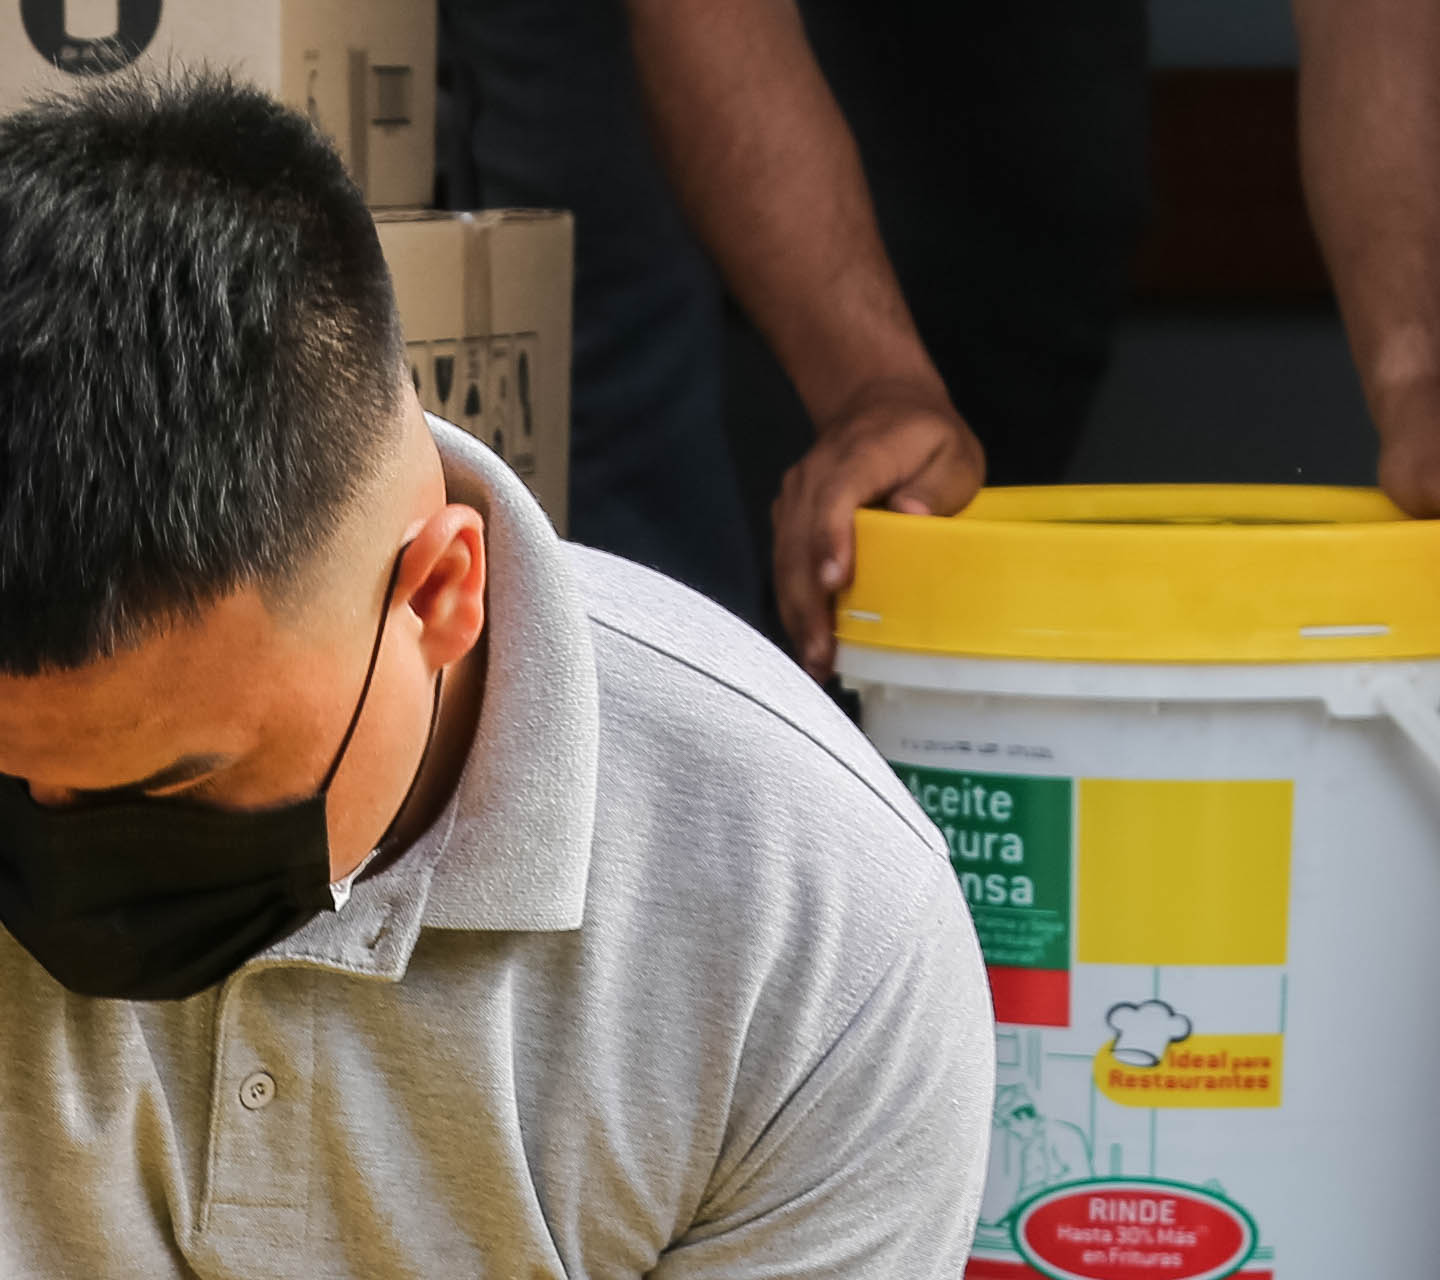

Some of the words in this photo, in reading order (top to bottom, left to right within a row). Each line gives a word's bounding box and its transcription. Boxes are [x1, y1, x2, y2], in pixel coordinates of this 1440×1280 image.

[1108, 1068, 1270, 1090] Restaurantes
[1088, 1197, 1177, 1224] RINDE
[1056, 1224, 1113, 1244] Hasta
[1082, 1250, 1105, 1265] en
[1108, 1247, 1183, 1268] Frituras
